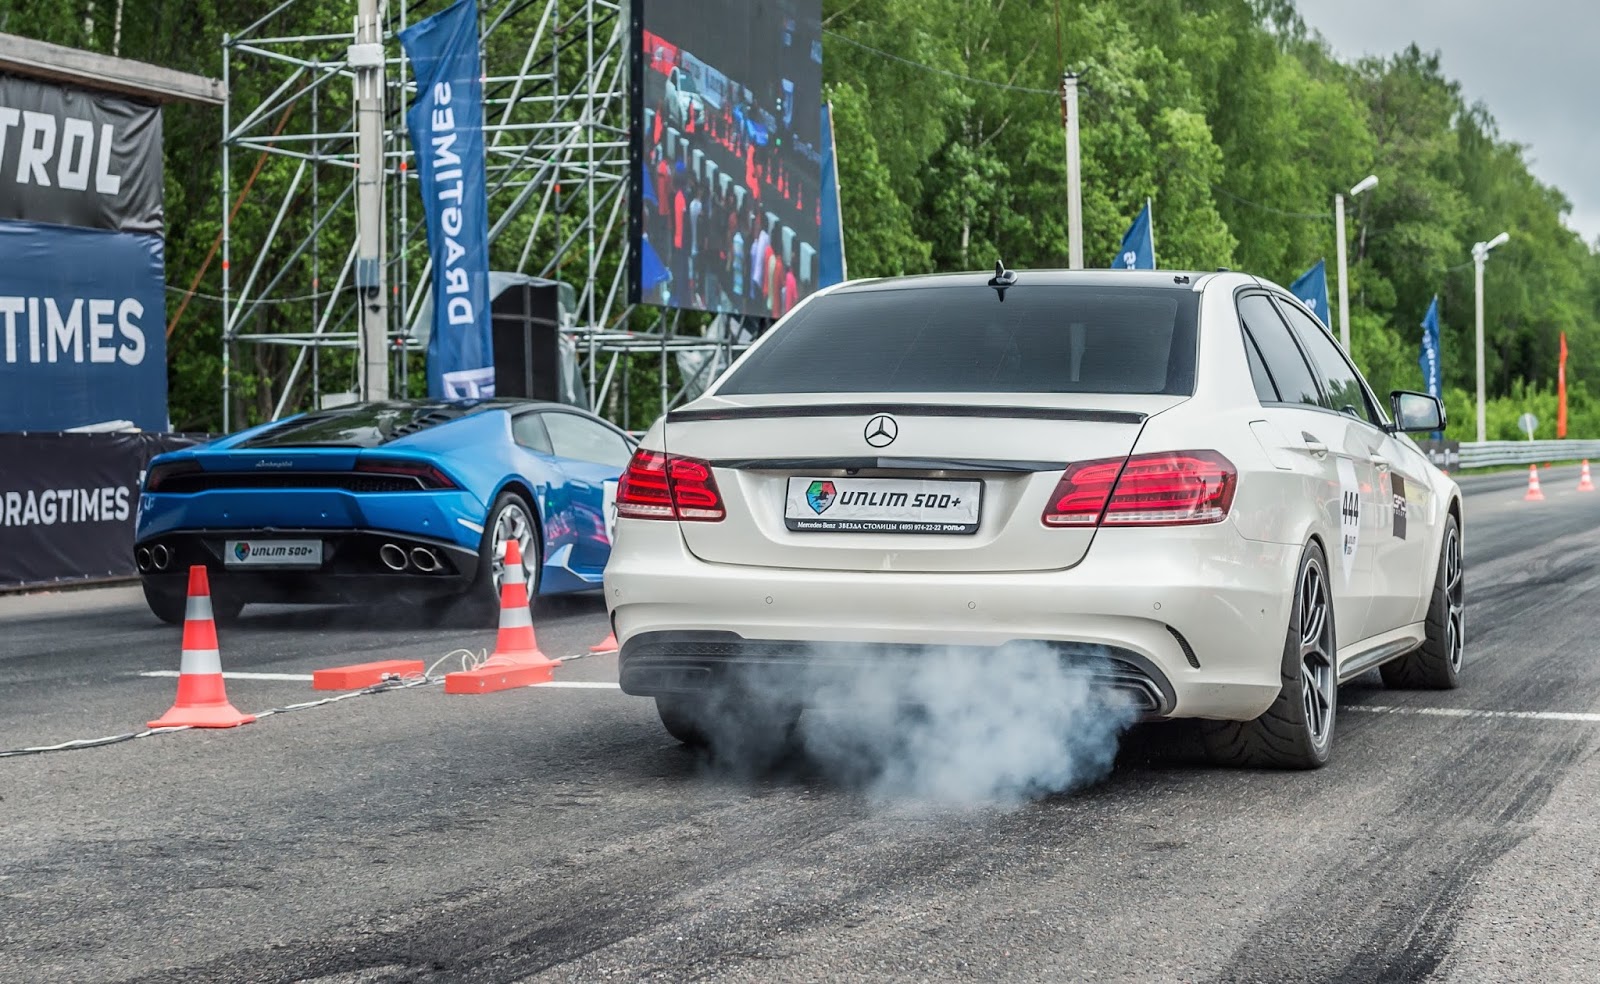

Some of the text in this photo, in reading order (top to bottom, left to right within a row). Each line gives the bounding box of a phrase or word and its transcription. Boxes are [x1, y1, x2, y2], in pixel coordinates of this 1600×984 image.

[0, 296, 146, 366] TIMES
[0, 486, 130, 526] RAGTIMES
[839, 491, 961, 509] UNLIM 500+
[1343, 491, 1358, 526] 444
[251, 546, 313, 557] UNLIM 500+
